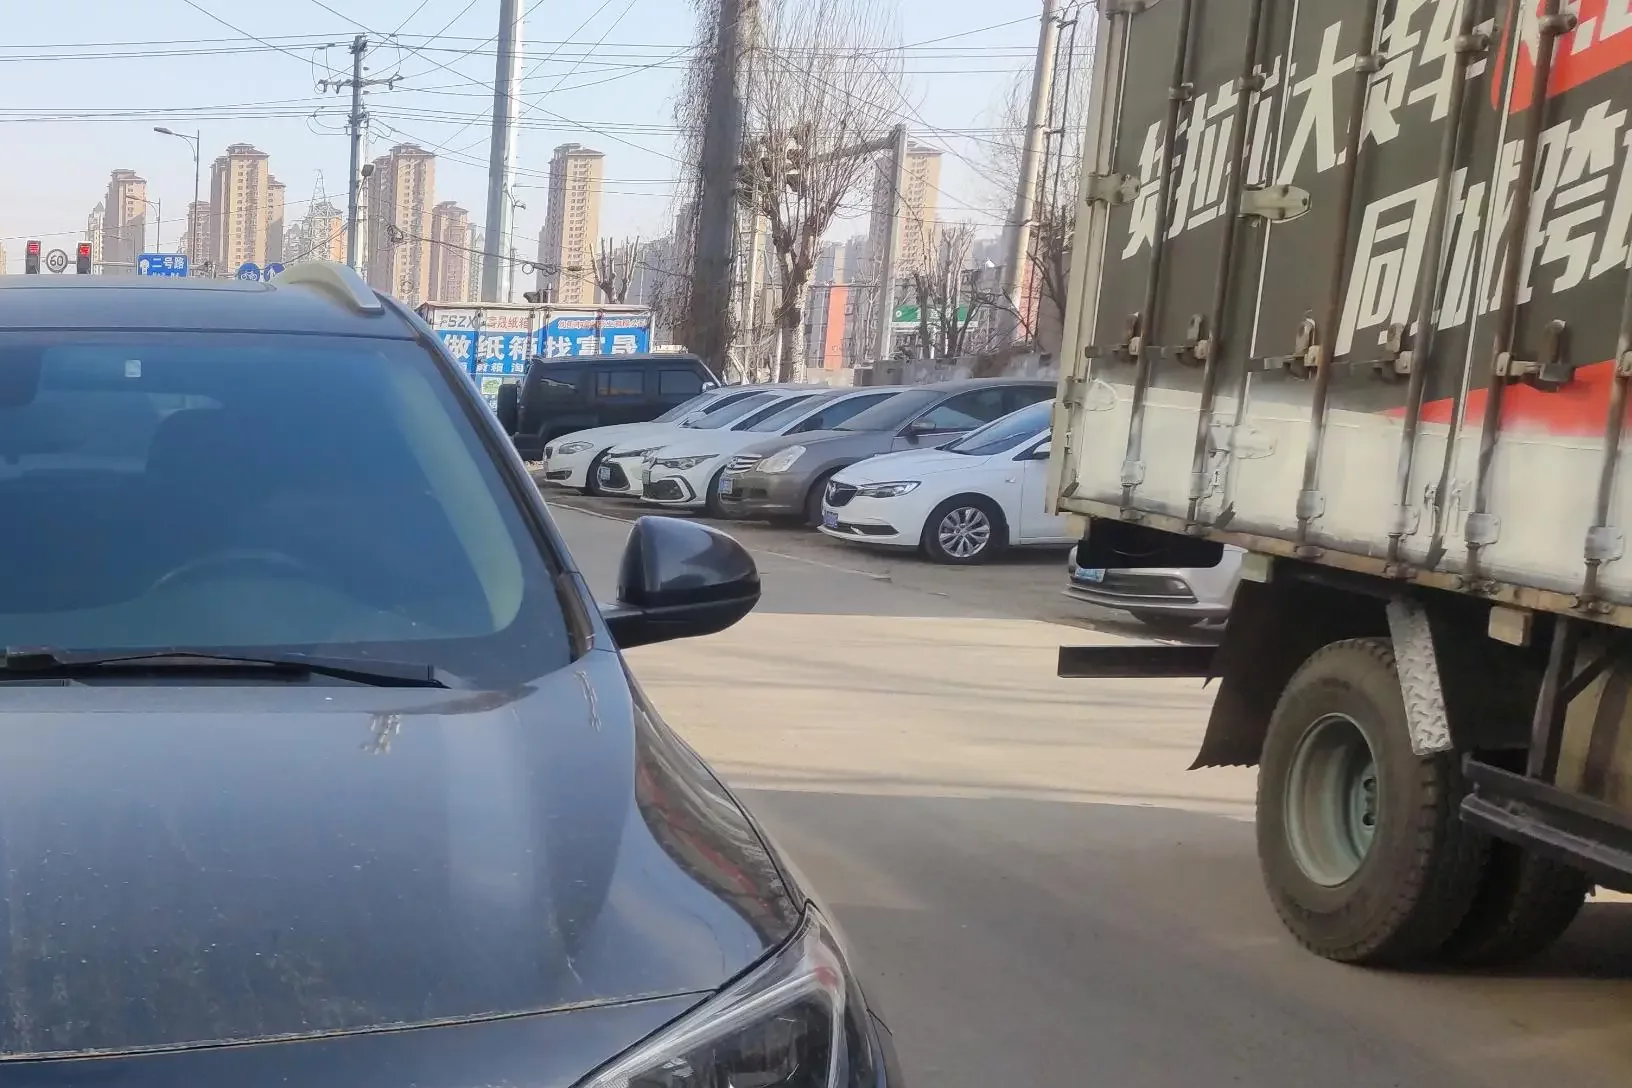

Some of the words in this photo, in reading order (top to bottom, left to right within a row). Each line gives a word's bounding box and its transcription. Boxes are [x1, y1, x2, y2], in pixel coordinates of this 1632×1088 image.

[49, 255, 64, 267] 60
[151, 256, 185, 270] 二号路
